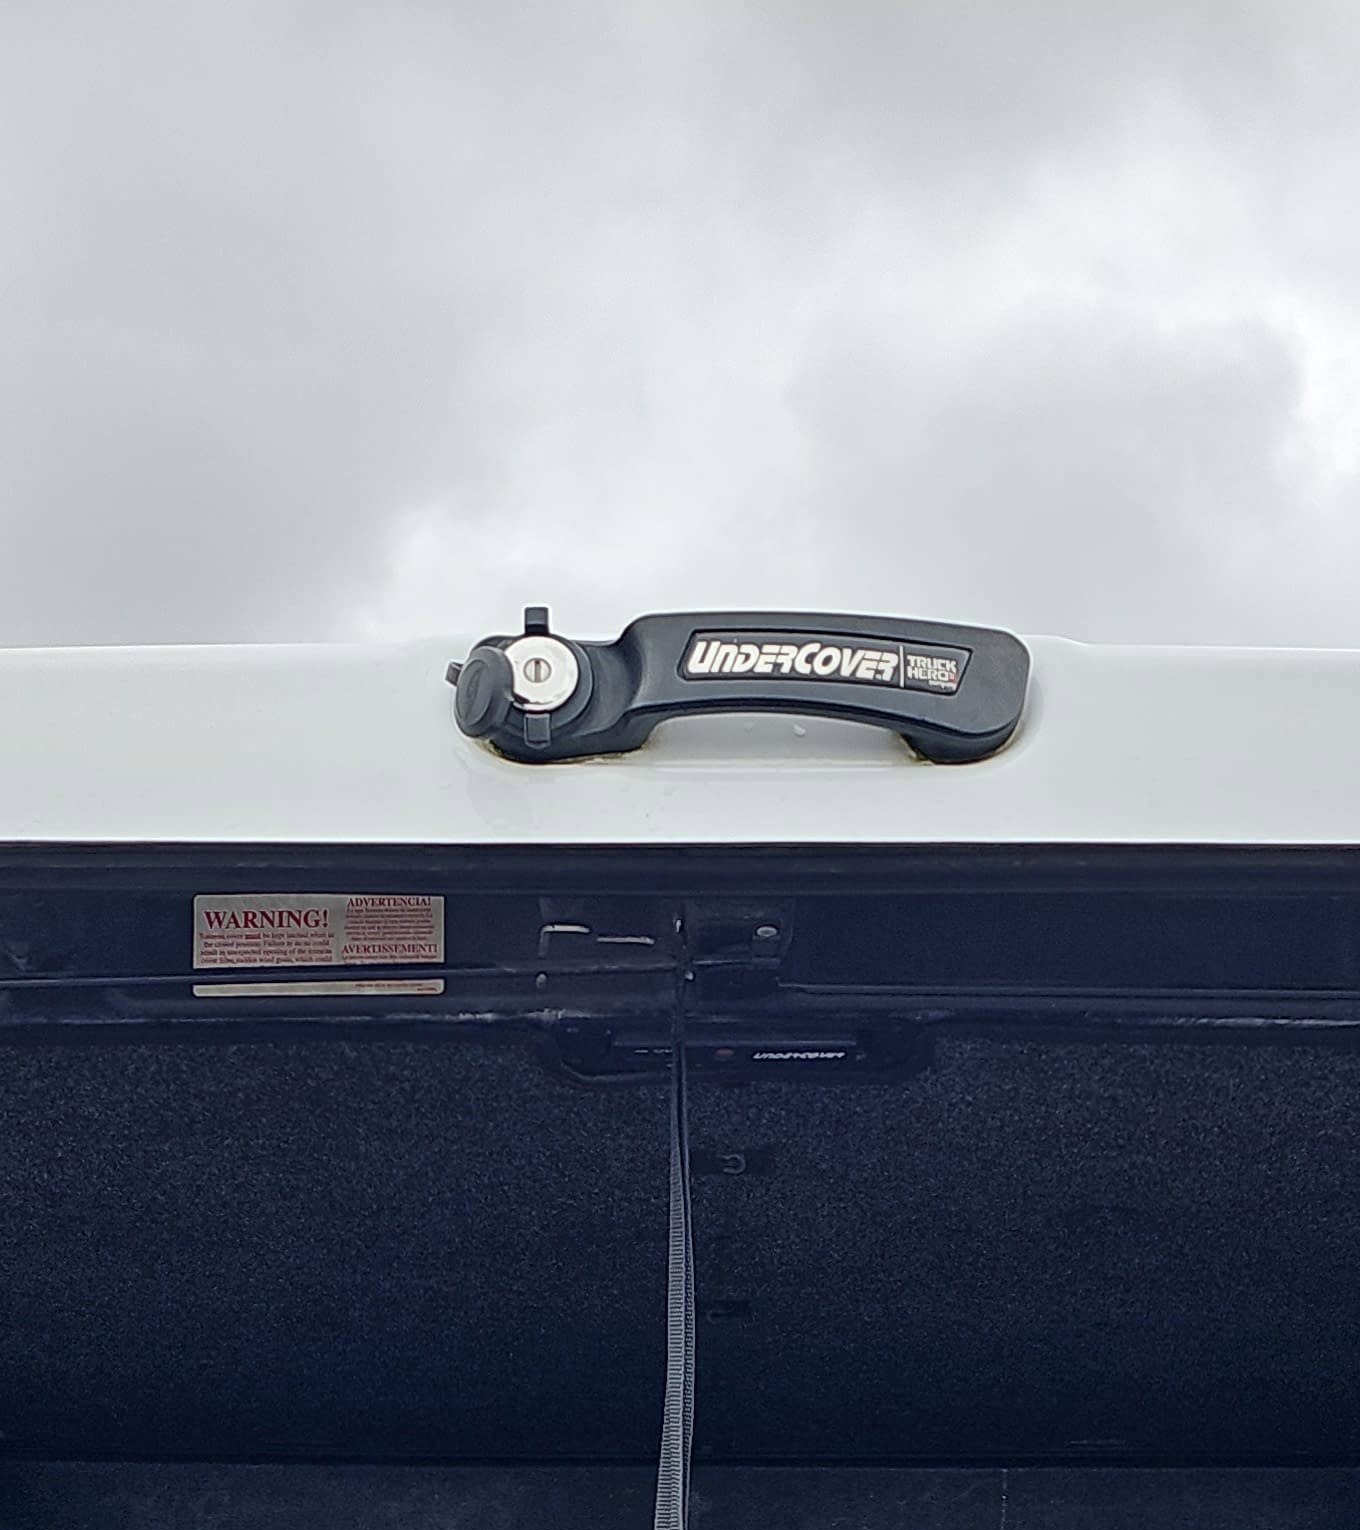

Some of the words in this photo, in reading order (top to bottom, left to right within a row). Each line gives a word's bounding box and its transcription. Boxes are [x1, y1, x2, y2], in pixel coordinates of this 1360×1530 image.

[688, 640, 898, 682] UNDERCOVER
[907, 655, 956, 674] TRUCK
[907, 666, 949, 680] HERO
[347, 896, 431, 907] ADVERTENCIA!
[204, 909, 329, 929] WARNING!
[341, 943, 438, 954] AVERTISSEMENT!
